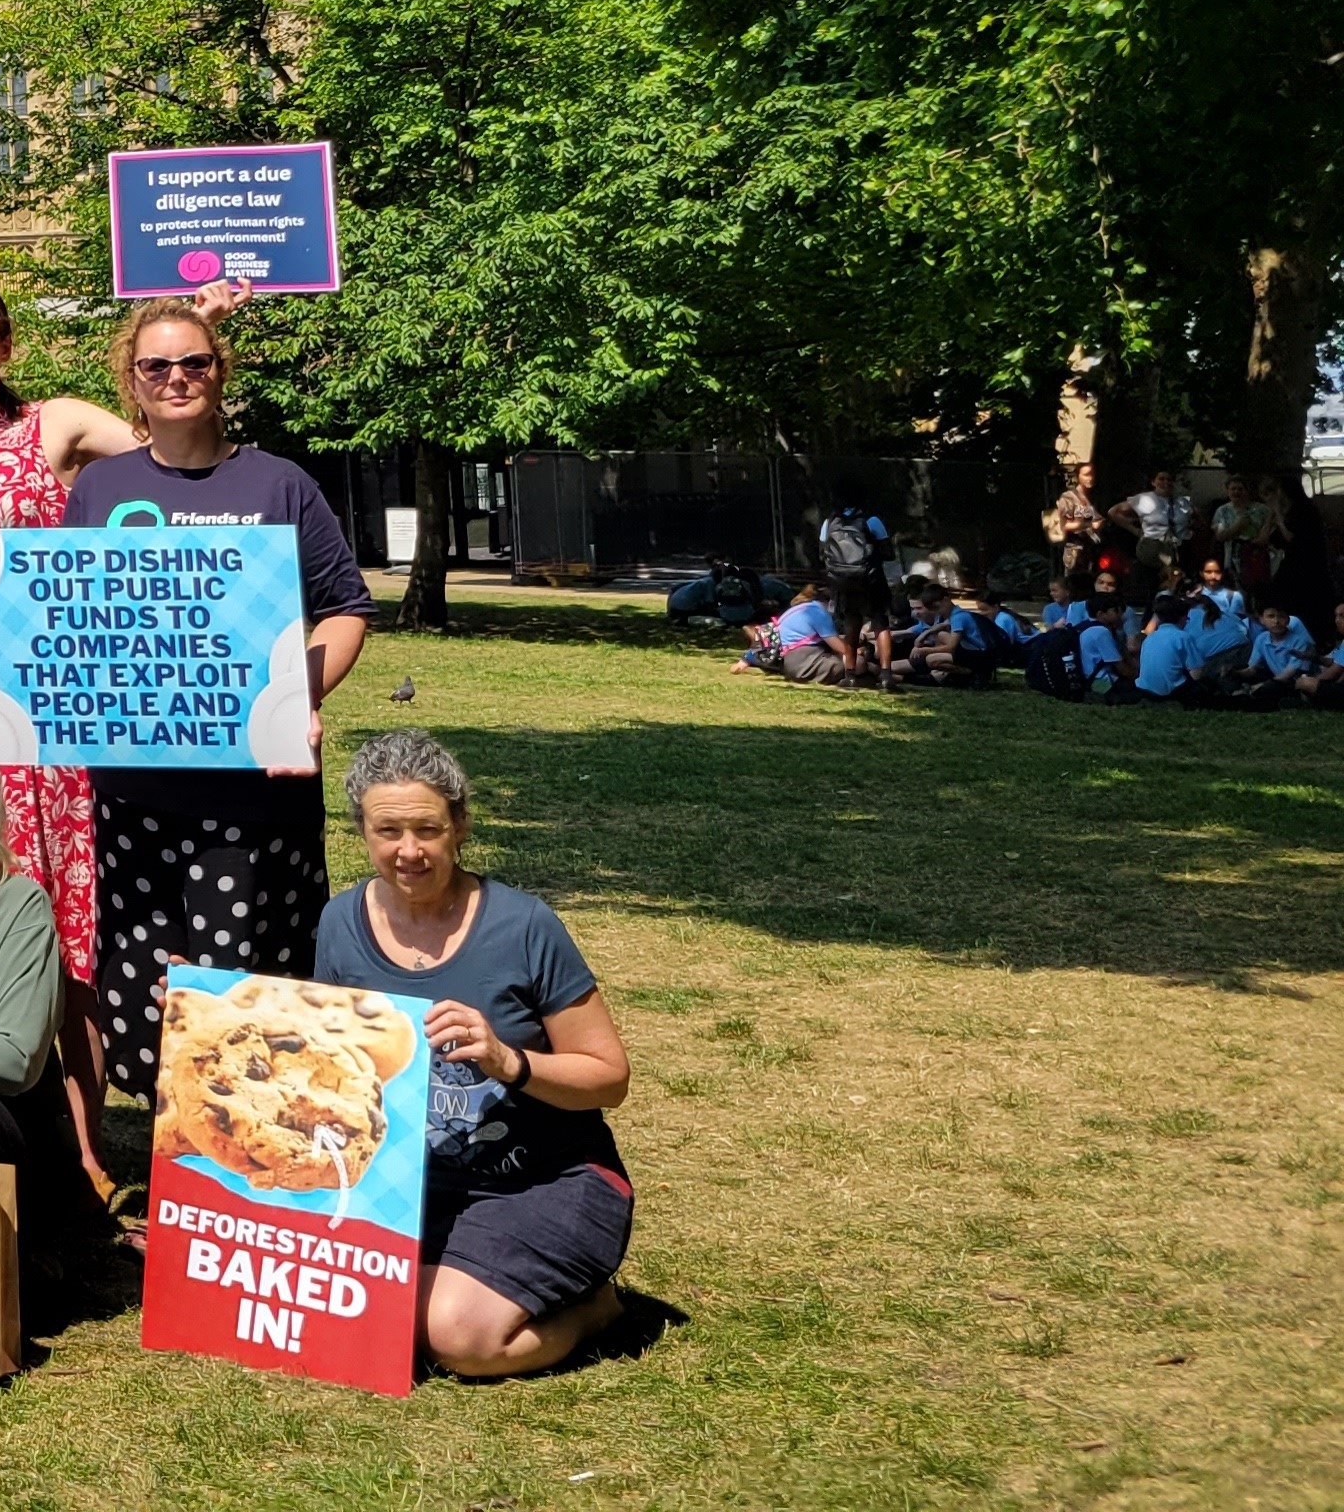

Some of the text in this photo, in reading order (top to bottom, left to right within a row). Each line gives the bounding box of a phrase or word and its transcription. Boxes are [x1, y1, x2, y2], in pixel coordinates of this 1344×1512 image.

[148, 166, 292, 188] I support a due
[156, 191, 281, 212] diligence law
[141, 216, 305, 233] to protect our human rights
[157, 233, 286, 247] and the environment!
[225, 252, 256, 260] GOOD
[225, 261, 270, 269] BUSINESS
[225, 269, 268, 277] MATTERS
[171, 512, 262, 525] Friends of
[9, 548, 243, 575] STOP DISHING
[29, 577, 226, 602] OUT PUBLIC
[47, 605, 211, 630] FUNDS TO
[31, 634, 231, 658] COMPANIES
[14, 663, 252, 687] THAT EXPLOIT
[31, 692, 241, 716] PEOPLE AND
[32, 720, 242, 746] THE PLANET
[158, 1199, 412, 1284] DEFORESTATION
[186, 1239, 367, 1318] BAKED
[236, 1298, 305, 1353] IN!
